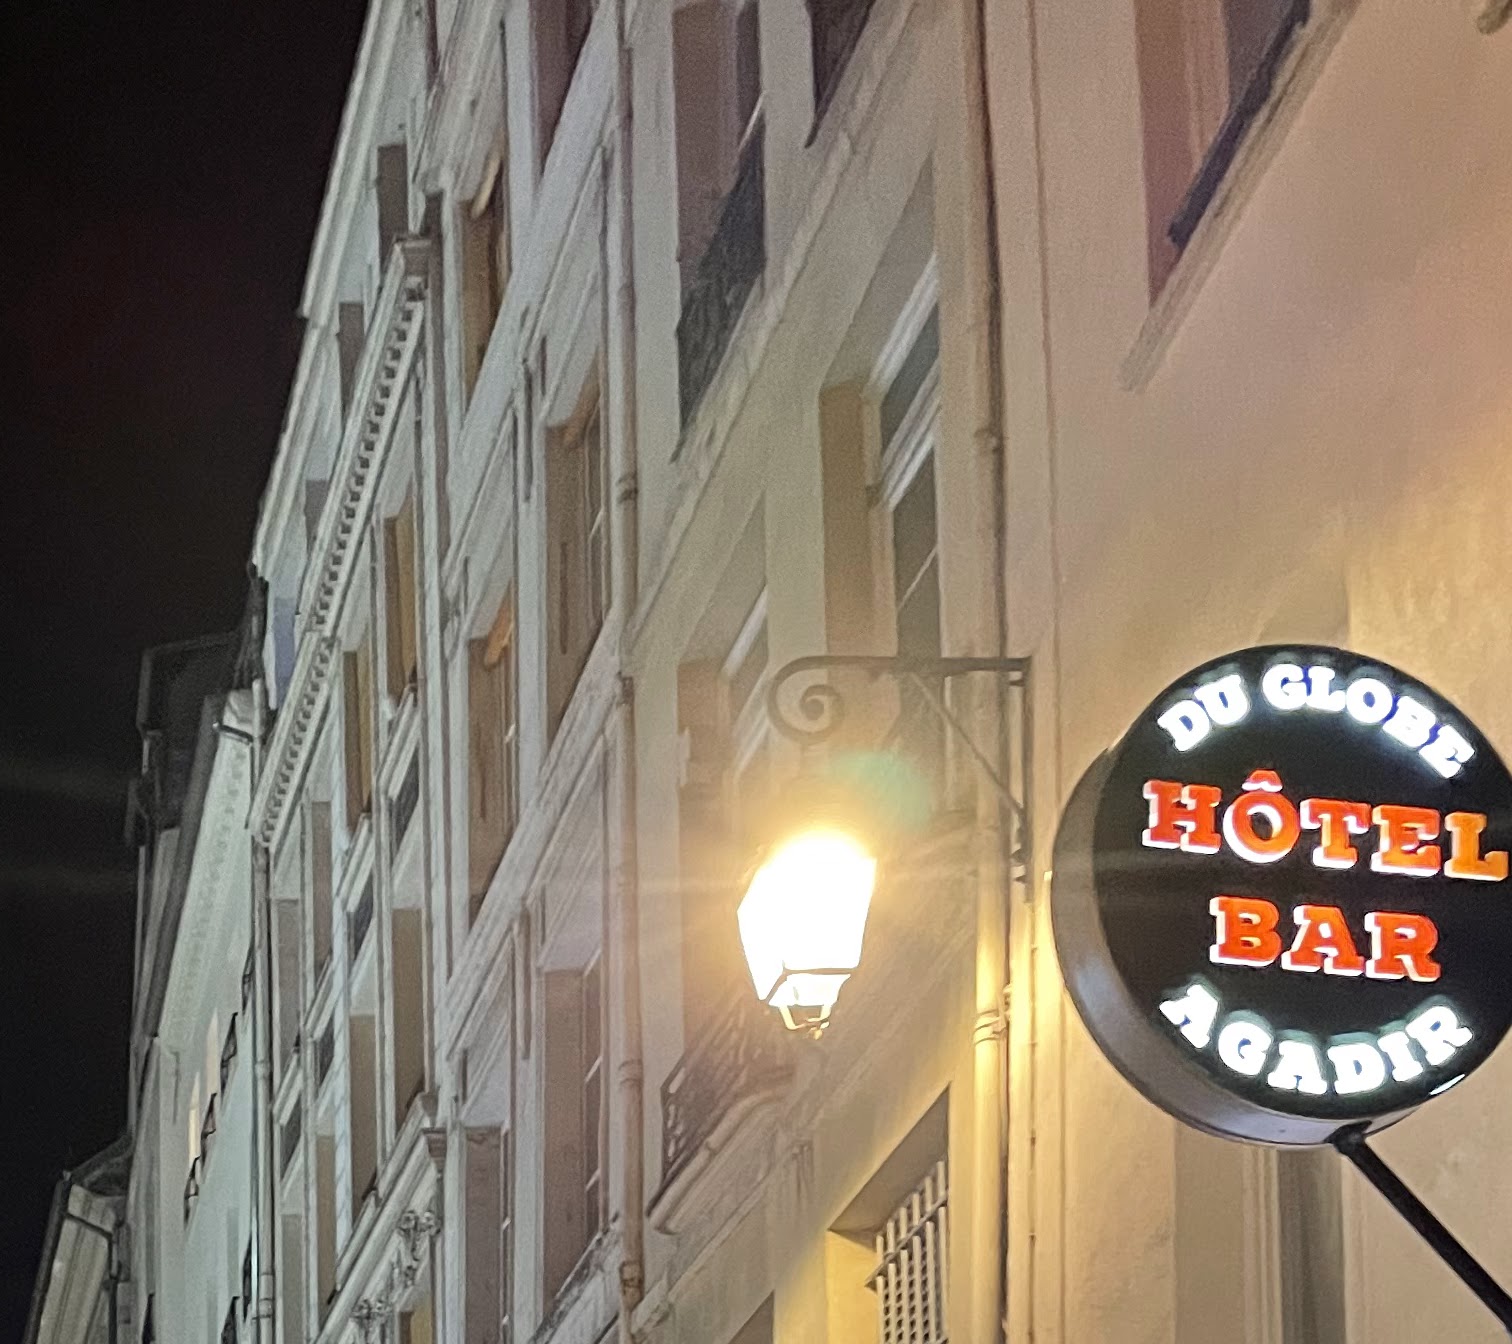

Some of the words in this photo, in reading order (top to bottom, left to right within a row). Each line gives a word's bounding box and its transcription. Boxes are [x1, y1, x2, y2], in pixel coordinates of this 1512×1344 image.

[1157, 675, 1248, 752] DU
[1262, 663, 1476, 779] GLOBE
[1142, 769, 1510, 881] HÔTEL
[1209, 895, 1442, 982] BAR
[1159, 983, 1473, 1096] AGADIR
